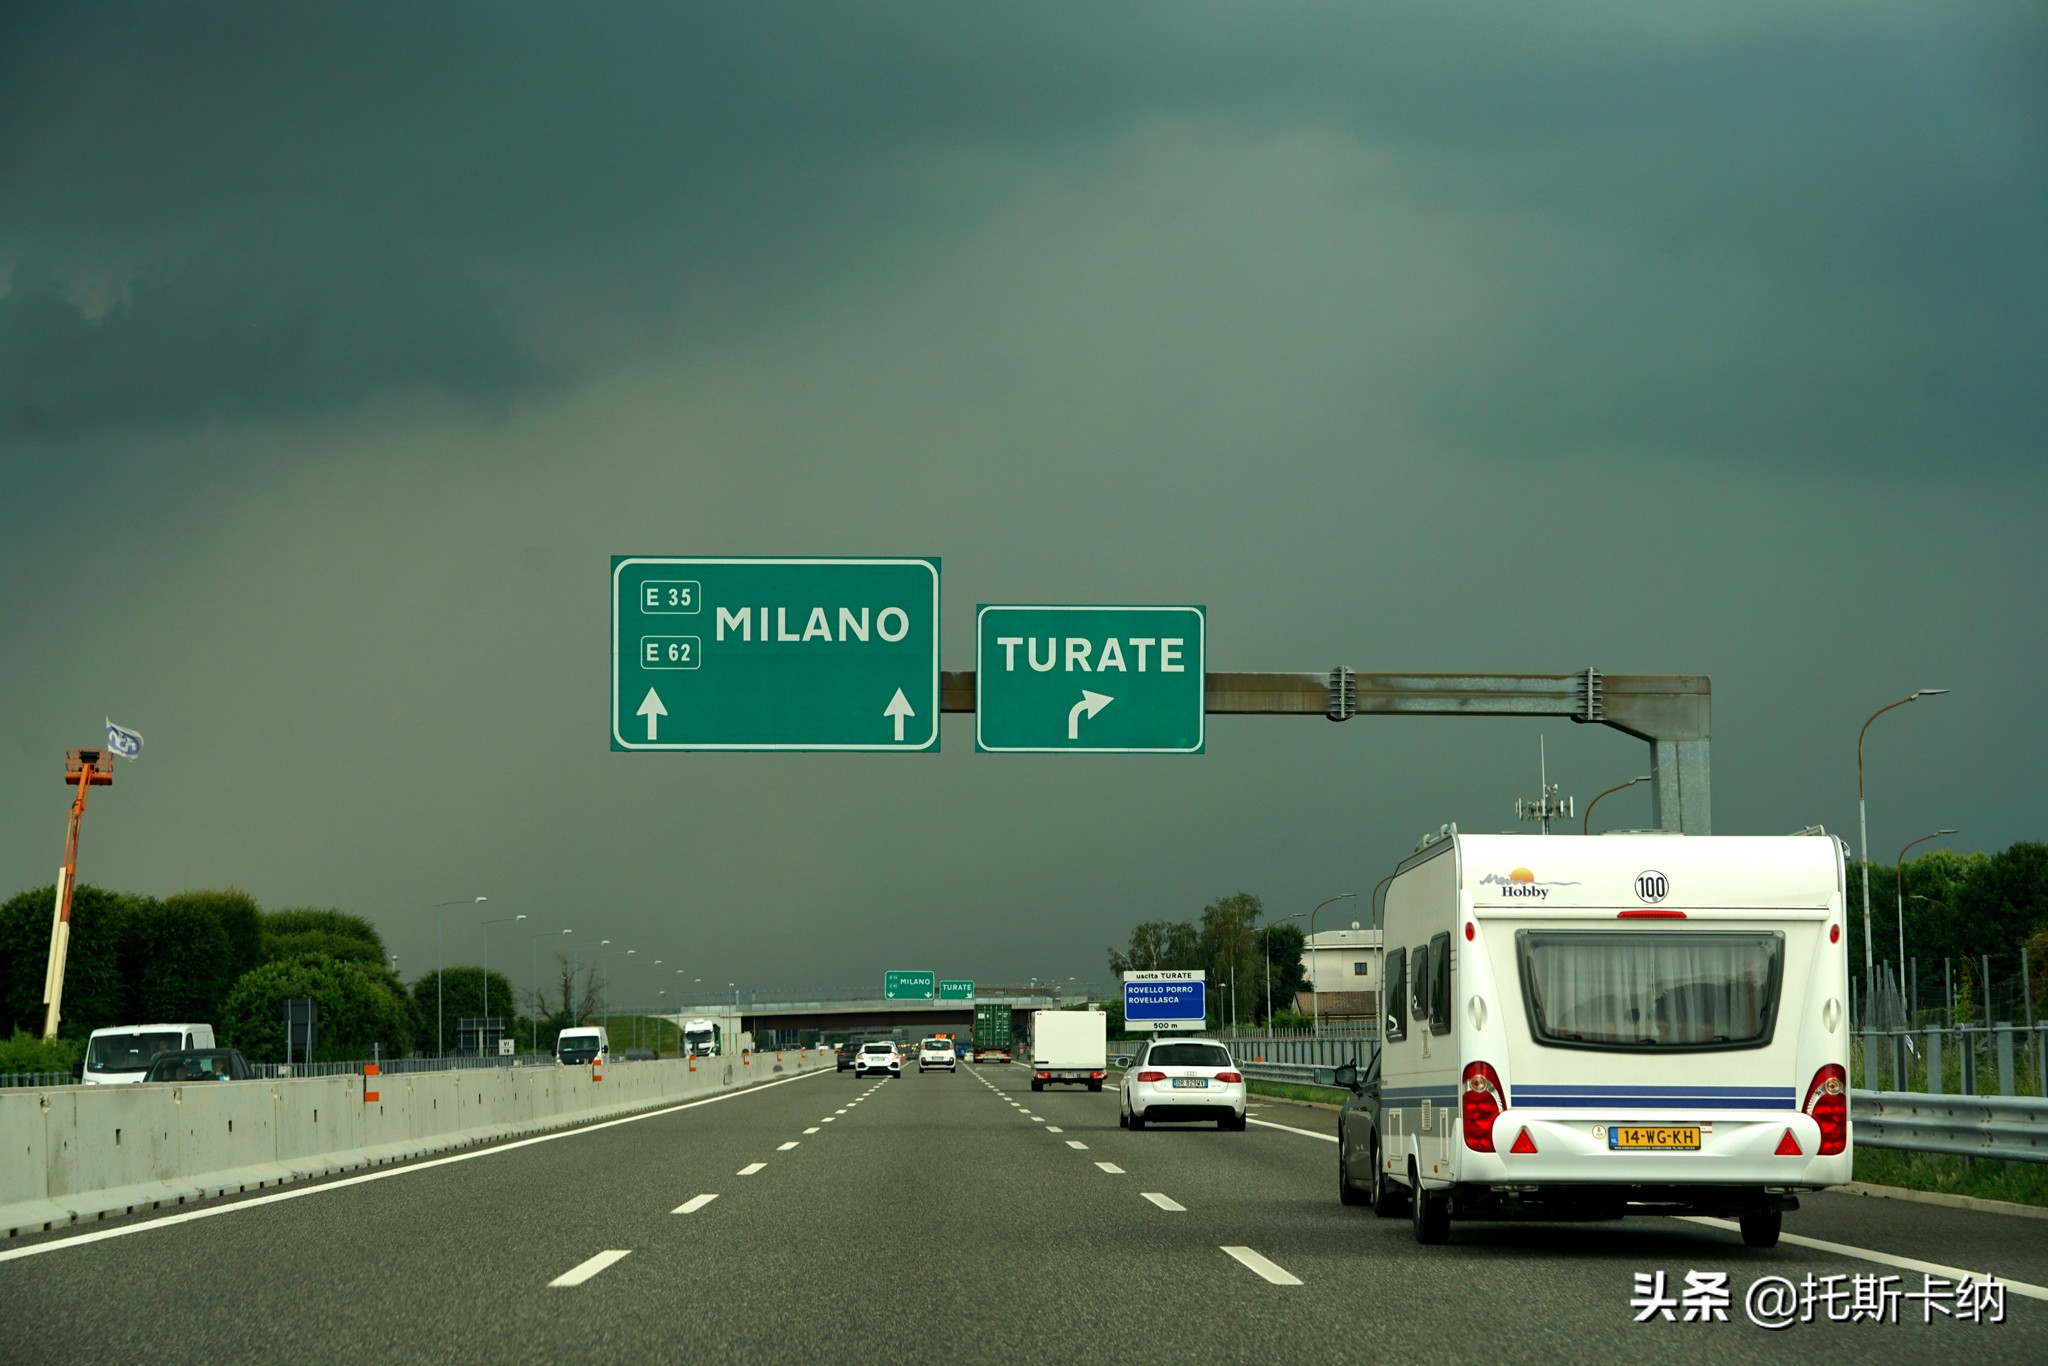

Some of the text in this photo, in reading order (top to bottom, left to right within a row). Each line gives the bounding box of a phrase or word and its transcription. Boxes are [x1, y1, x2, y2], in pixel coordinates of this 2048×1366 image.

[646, 588, 691, 606] E 35
[715, 606, 910, 643] MILANO
[646, 643, 691, 662] E 62
[997, 637, 1186, 673] TURATE
[1502, 885, 1549, 900] Hobby
[1637, 876, 1666, 898] 100
[900, 978, 931, 986] MILANO
[1128, 986, 1164, 994] ROVELLO
[1128, 996, 1179, 1004] ROVELLASCA
[1624, 1129, 1694, 1144] 14-WG-KH
